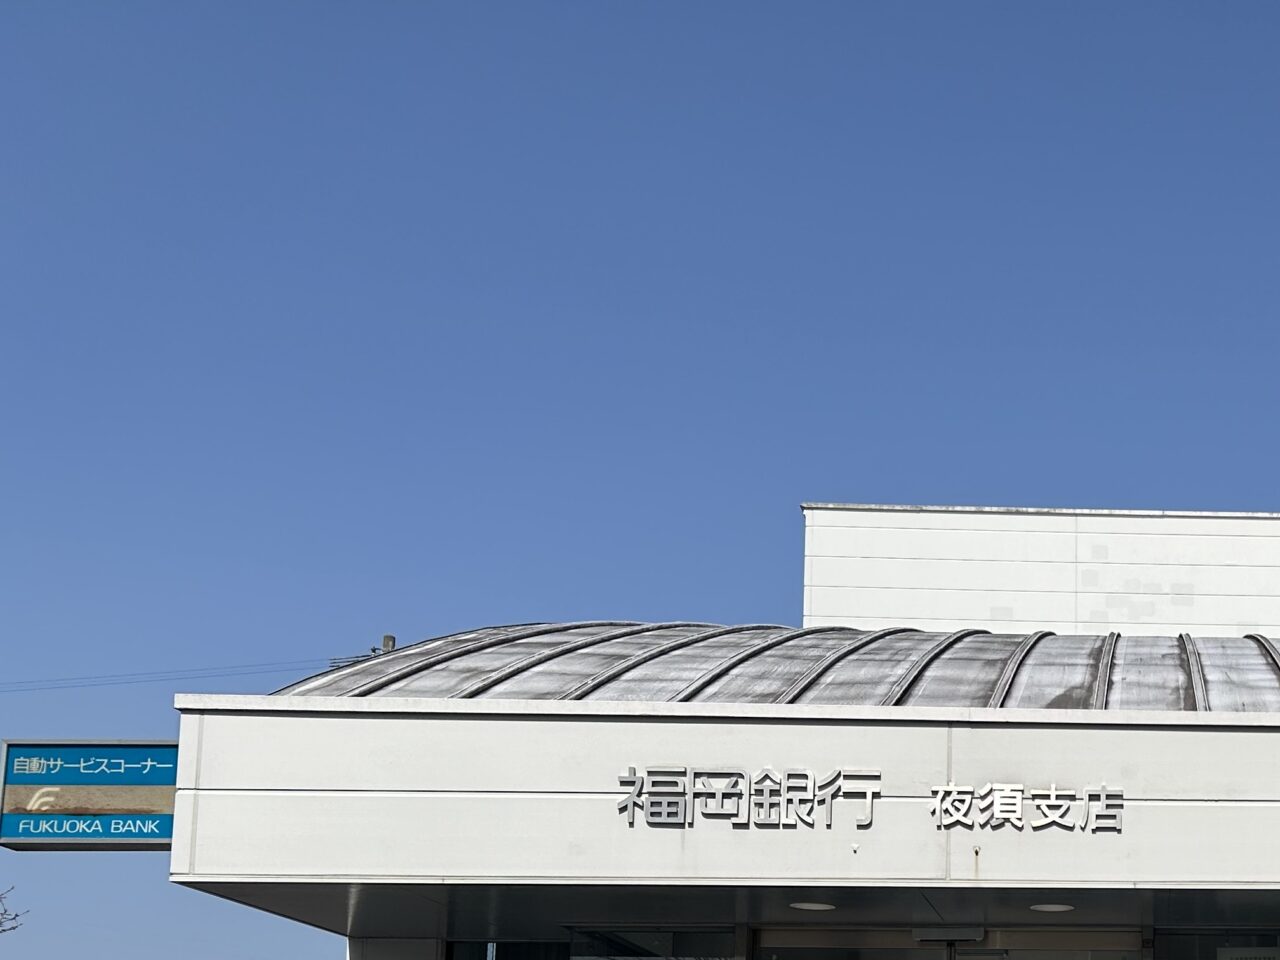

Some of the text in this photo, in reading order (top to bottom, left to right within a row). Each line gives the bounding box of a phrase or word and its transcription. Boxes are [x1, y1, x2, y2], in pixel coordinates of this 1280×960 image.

[13, 757, 173, 774] 自動サービスコーナー
[617, 766, 1124, 834] 福岡銀行 夜須支店
[18, 819, 160, 834] FUKUOKA BANK
